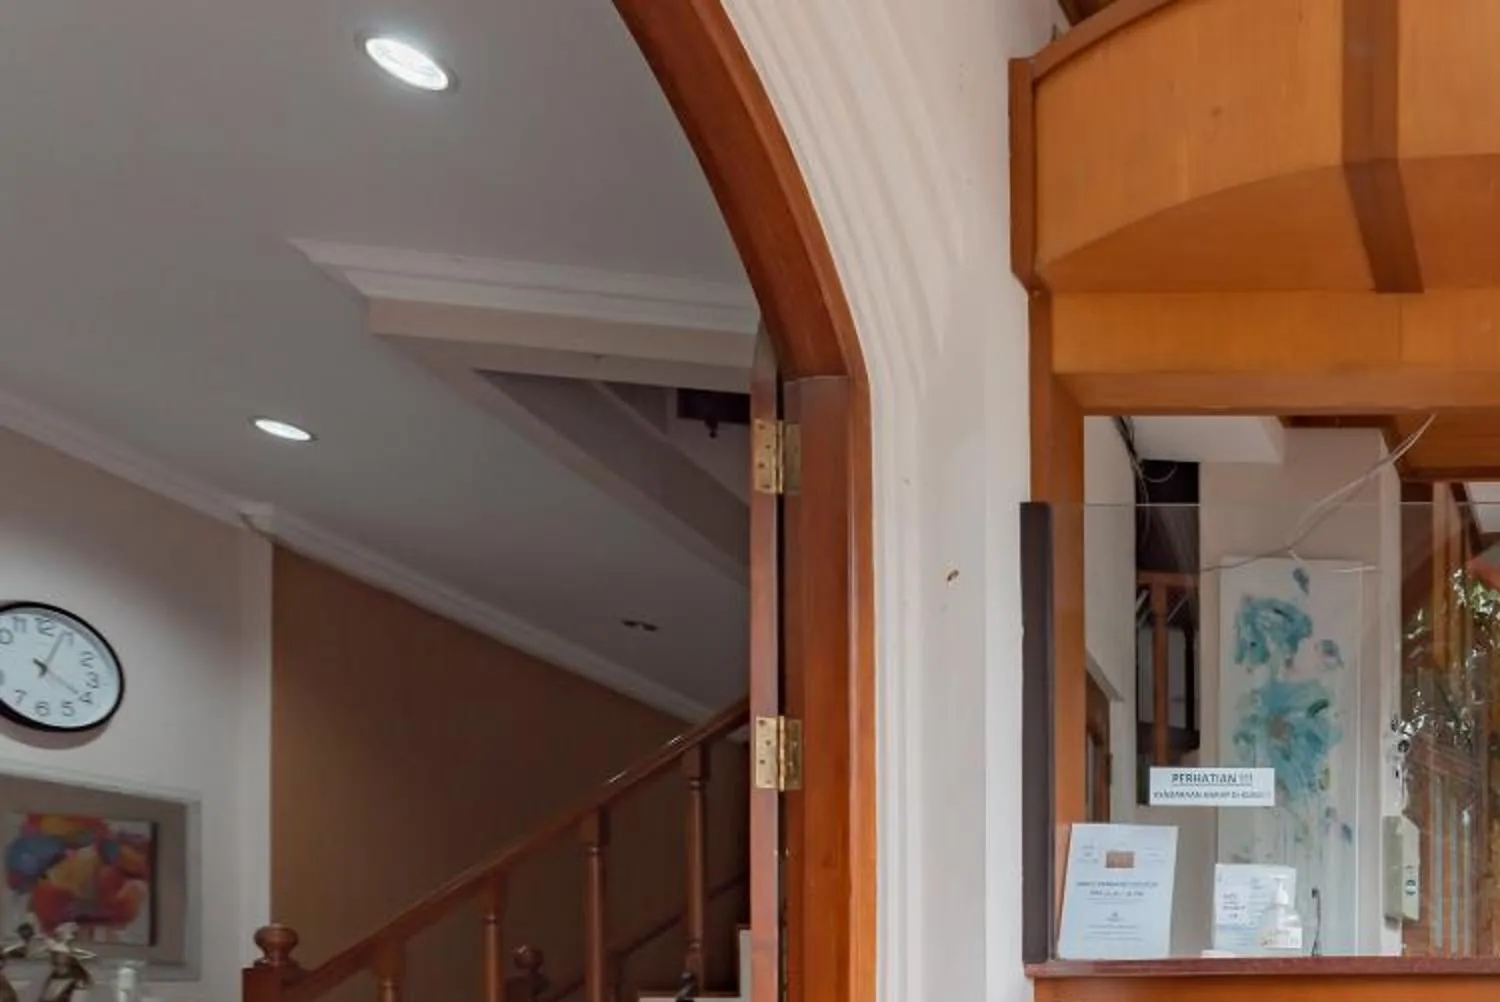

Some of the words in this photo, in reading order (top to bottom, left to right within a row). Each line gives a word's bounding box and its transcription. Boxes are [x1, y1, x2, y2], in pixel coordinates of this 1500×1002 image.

[35, 701, 50, 717] 6
[61, 701, 75, 717] 5
[1171, 773, 1237, 783] PERHATIAN
